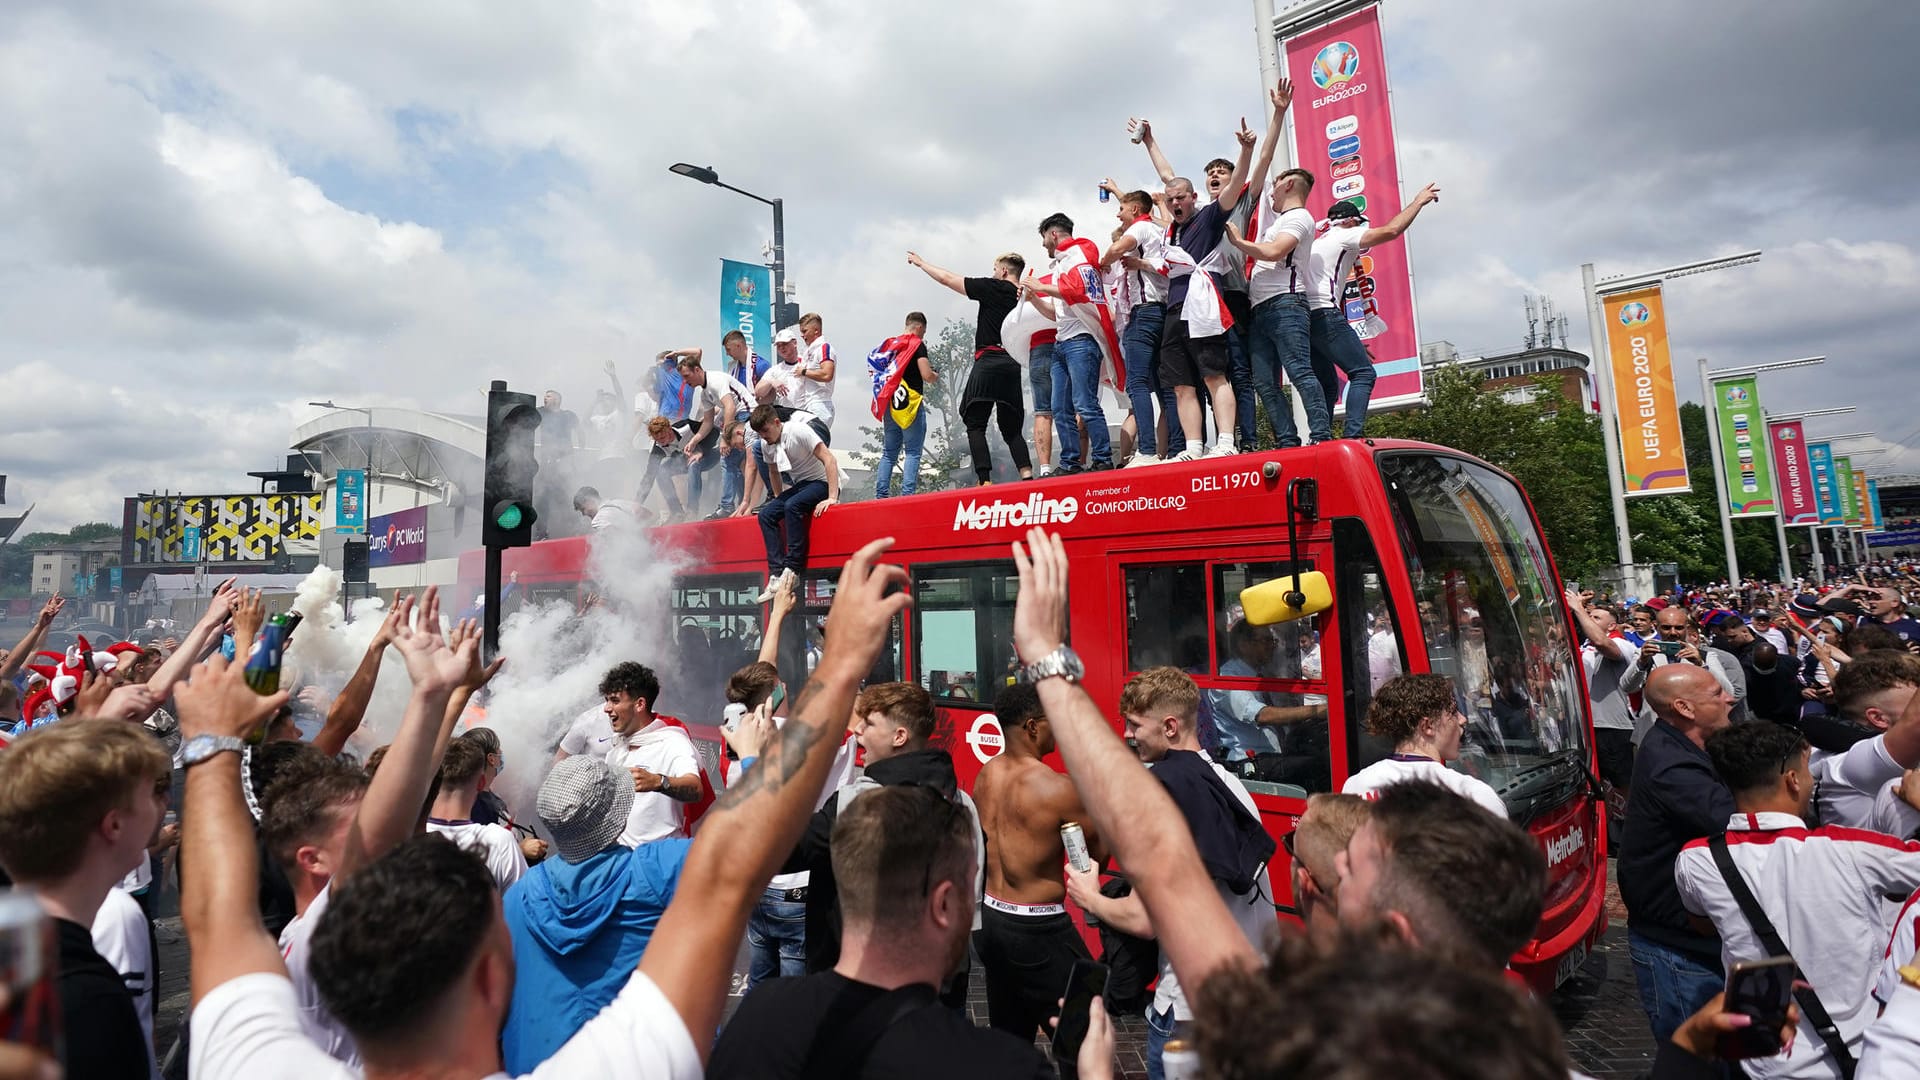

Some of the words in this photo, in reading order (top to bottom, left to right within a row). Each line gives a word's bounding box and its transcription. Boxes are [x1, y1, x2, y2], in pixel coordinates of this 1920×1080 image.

[1336, 181, 1360, 194] FedEx
[1630, 336, 1651, 376] 2020
[1636, 376, 1656, 417] EURO
[1642, 419, 1661, 460] UEFA
[1785, 445, 1796, 466] 2020
[1788, 466, 1800, 487] EURO
[1085, 489, 1092, 498] A
[1092, 486, 1121, 497] member
[1122, 485, 1131, 494] of
[1791, 487, 1803, 509] UEFA
[953, 492, 1079, 531] Metroline
[369, 534, 387, 552] Currys
[980, 736, 999, 744] BUSES
[1546, 824, 1585, 868] Metroline
[996, 903, 1018, 912] MOSCHINO
[1028, 906, 1057, 914] MOSCHINO
